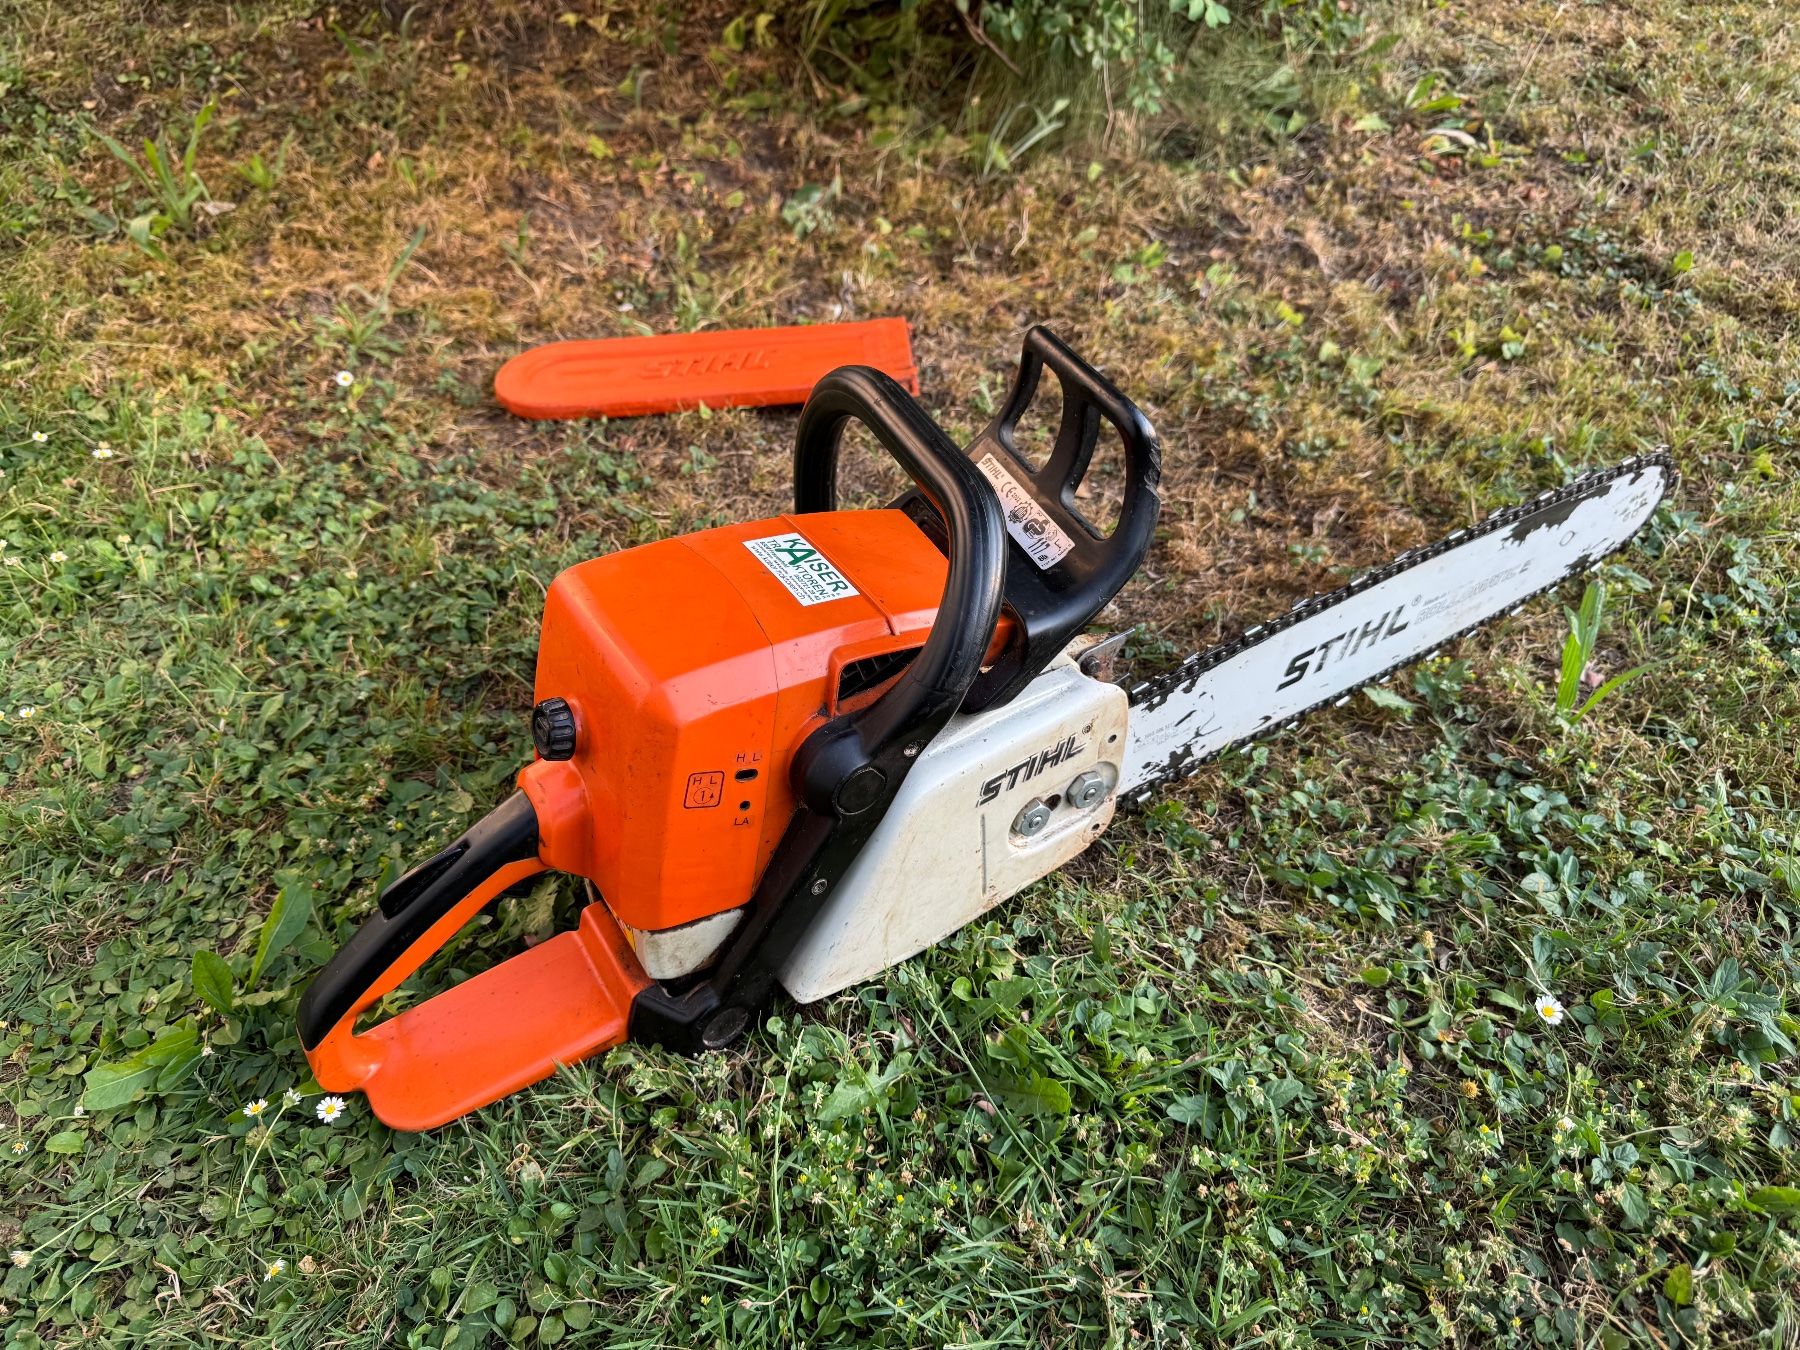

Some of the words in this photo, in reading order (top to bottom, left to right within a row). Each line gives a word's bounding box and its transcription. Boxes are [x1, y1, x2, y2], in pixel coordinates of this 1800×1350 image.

[980, 457, 1001, 480] STIHL
[775, 538, 849, 592] KAISER
[1275, 604, 1410, 693] STIHL
[736, 753, 745, 762] H
[752, 753, 761, 762] L
[976, 733, 1088, 808] STIHL
[692, 776, 702, 786] H
[709, 776, 718, 785] L
